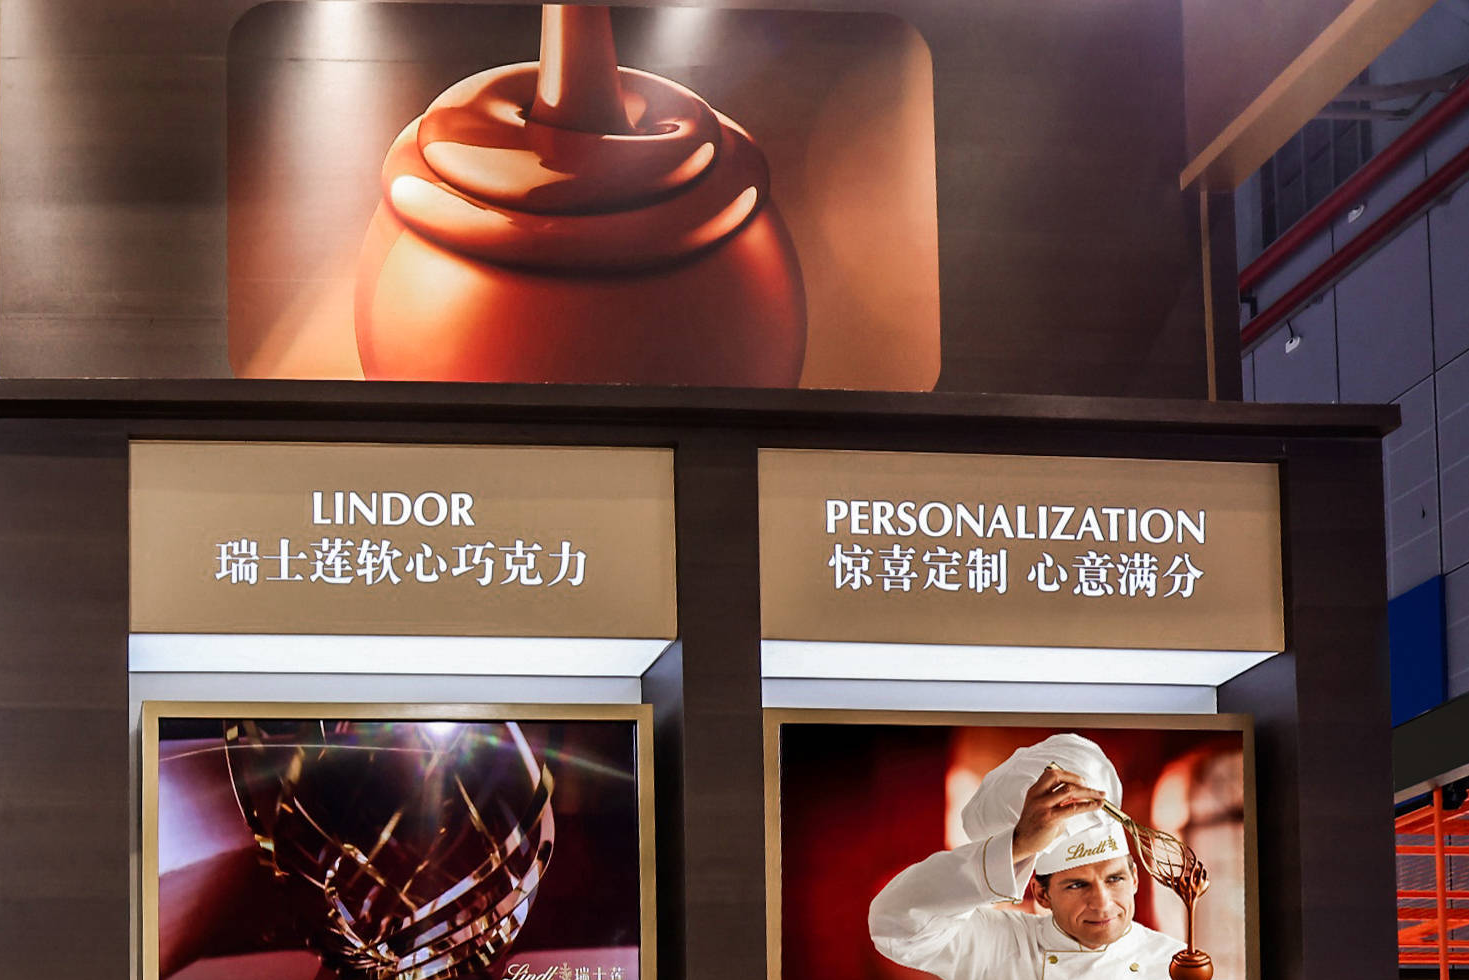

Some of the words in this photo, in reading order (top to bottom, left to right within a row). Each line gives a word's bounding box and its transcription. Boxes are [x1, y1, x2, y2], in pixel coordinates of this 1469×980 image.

[311, 491, 475, 527] LINDOR
[825, 498, 1206, 545] PERSONALIZATION
[214, 537, 588, 587] 瑞士莲软心巧克力
[828, 542, 1008, 594] 惊喜定制
[1027, 550, 1205, 599] 心意满分
[1065, 840, 1107, 862] Lindt
